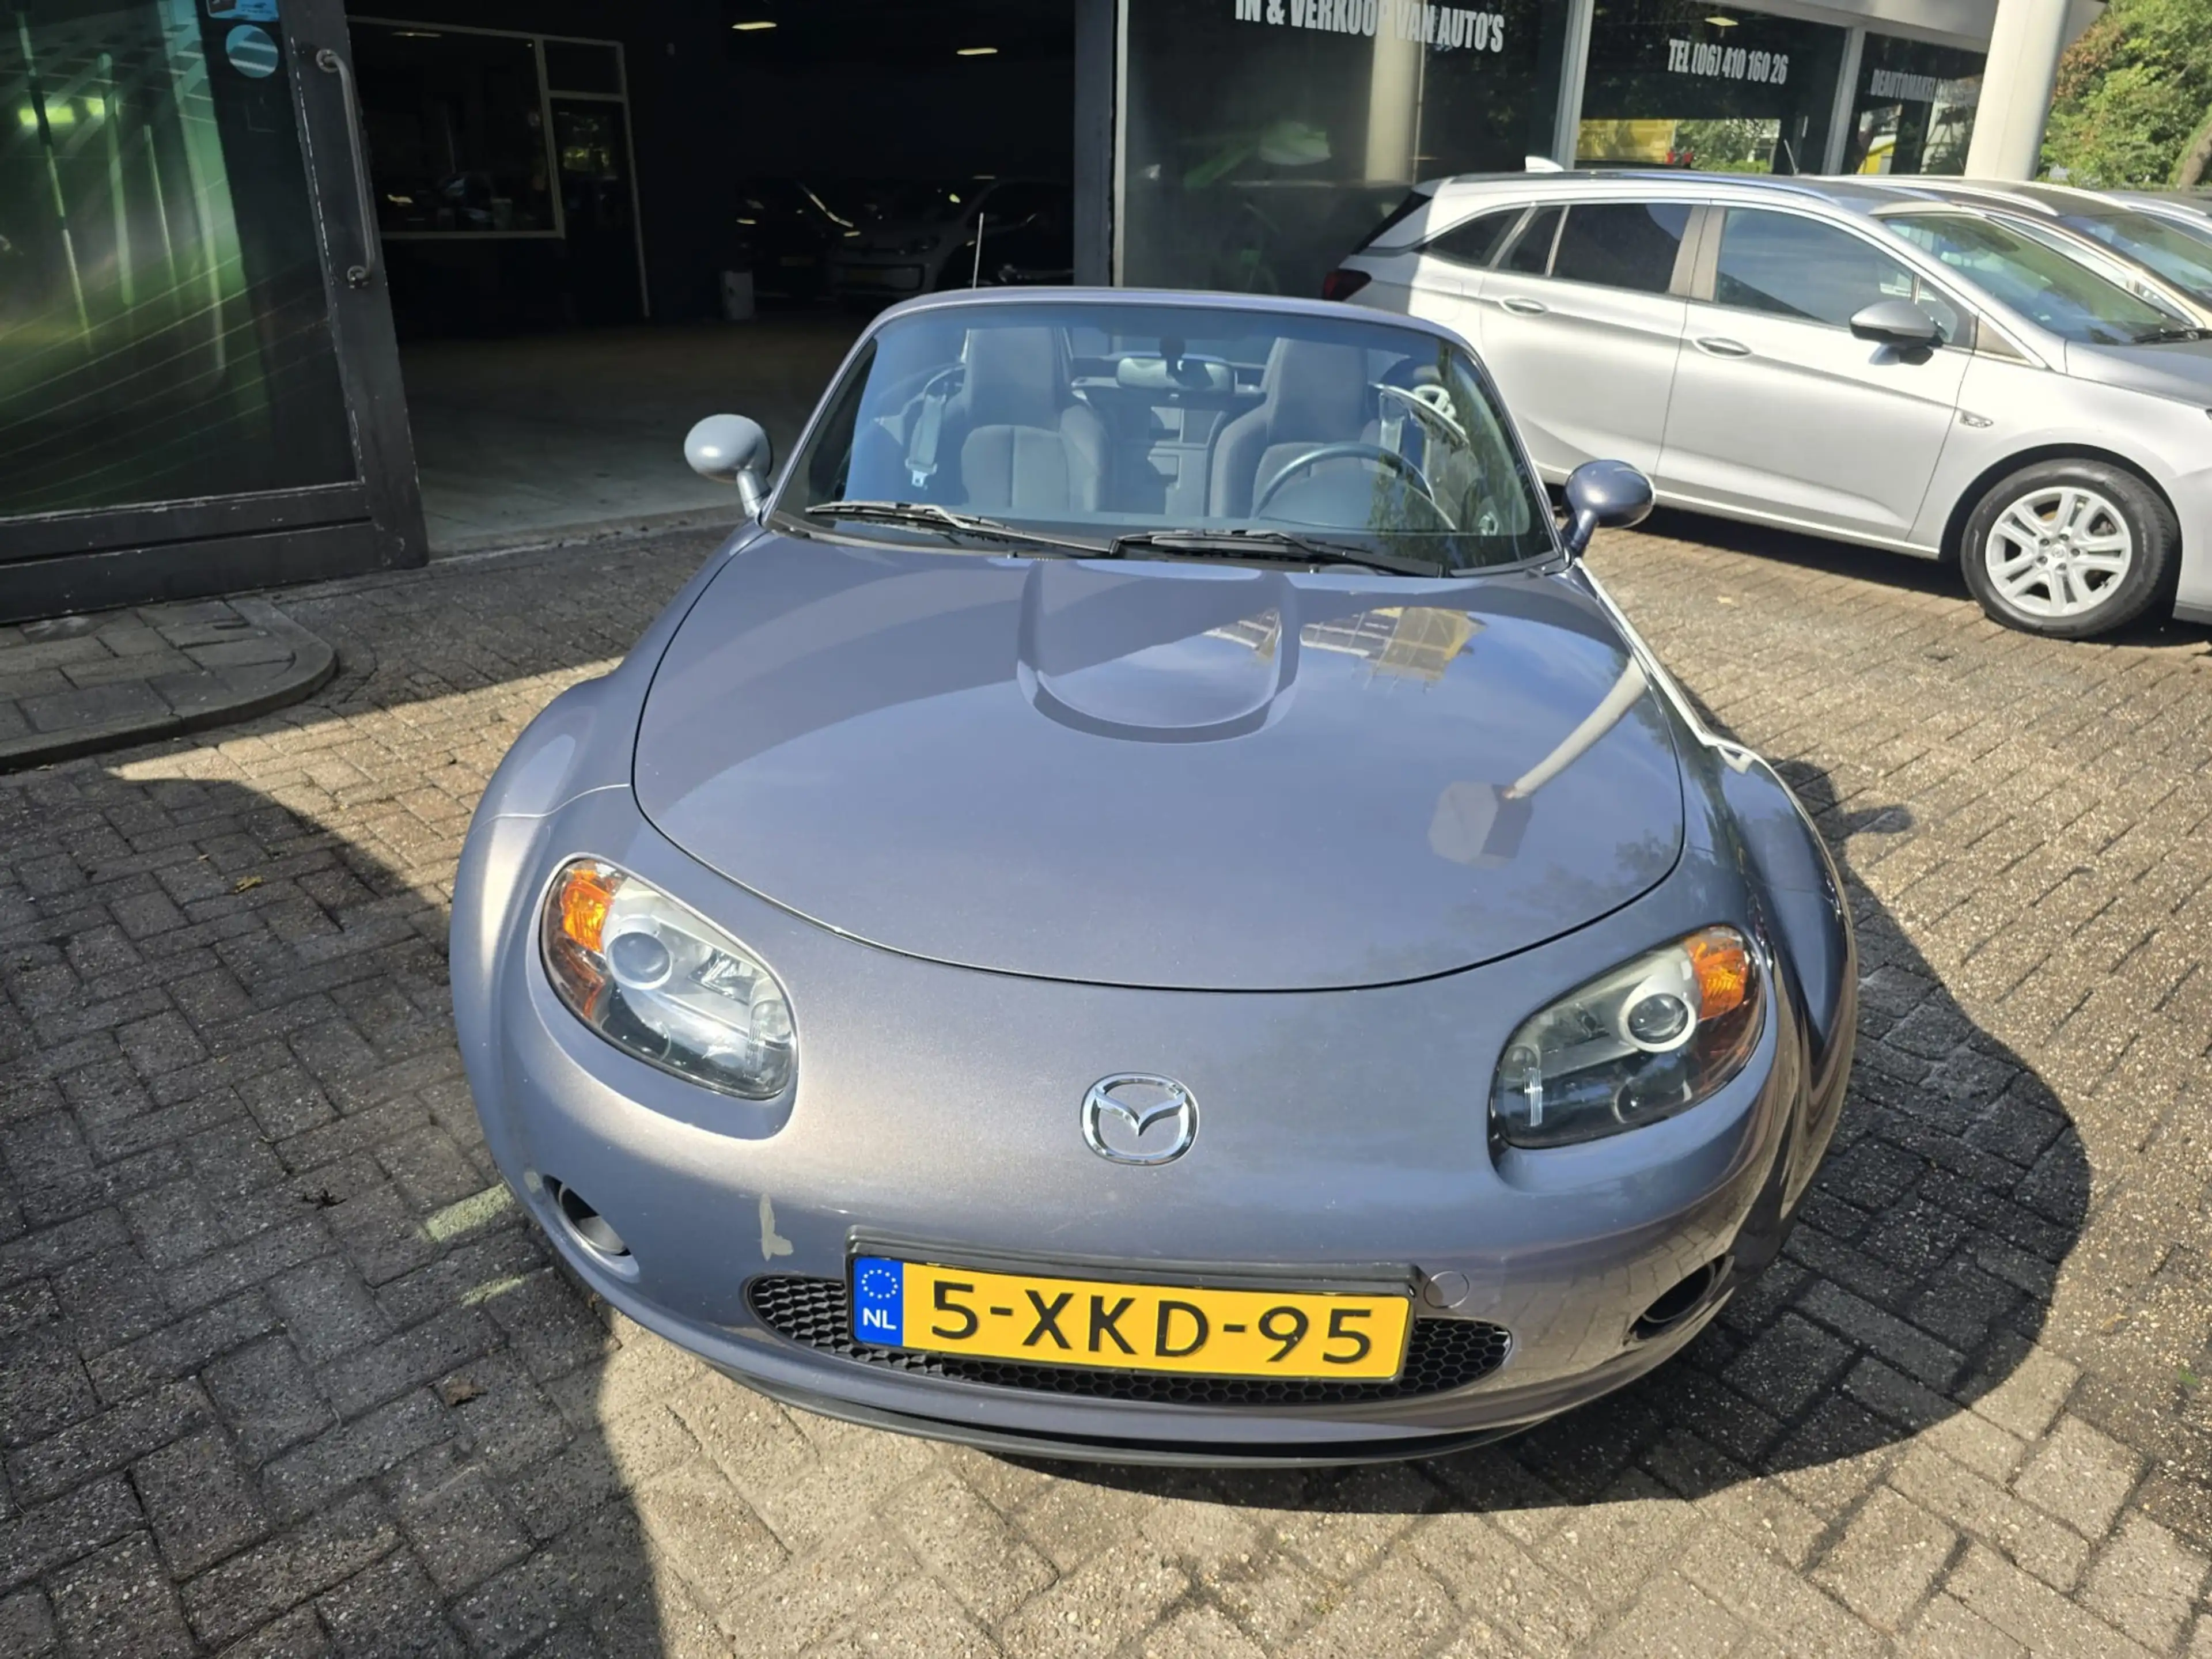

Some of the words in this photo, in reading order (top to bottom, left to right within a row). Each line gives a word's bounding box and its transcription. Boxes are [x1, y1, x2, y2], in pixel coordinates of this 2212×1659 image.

[1395, 1, 1436, 44] VAN
[1436, 6, 1505, 52] AUTO'S
[1668, 38, 1691, 73] TEL
[1691, 42, 1722, 77] (06)
[1721, 46, 1747, 79] 410
[1747, 50, 1771, 82] 160
[1770, 53, 1789, 85] 26
[863, 1307, 897, 1331] NL
[931, 1279, 1372, 1364] 5-XKD-95
